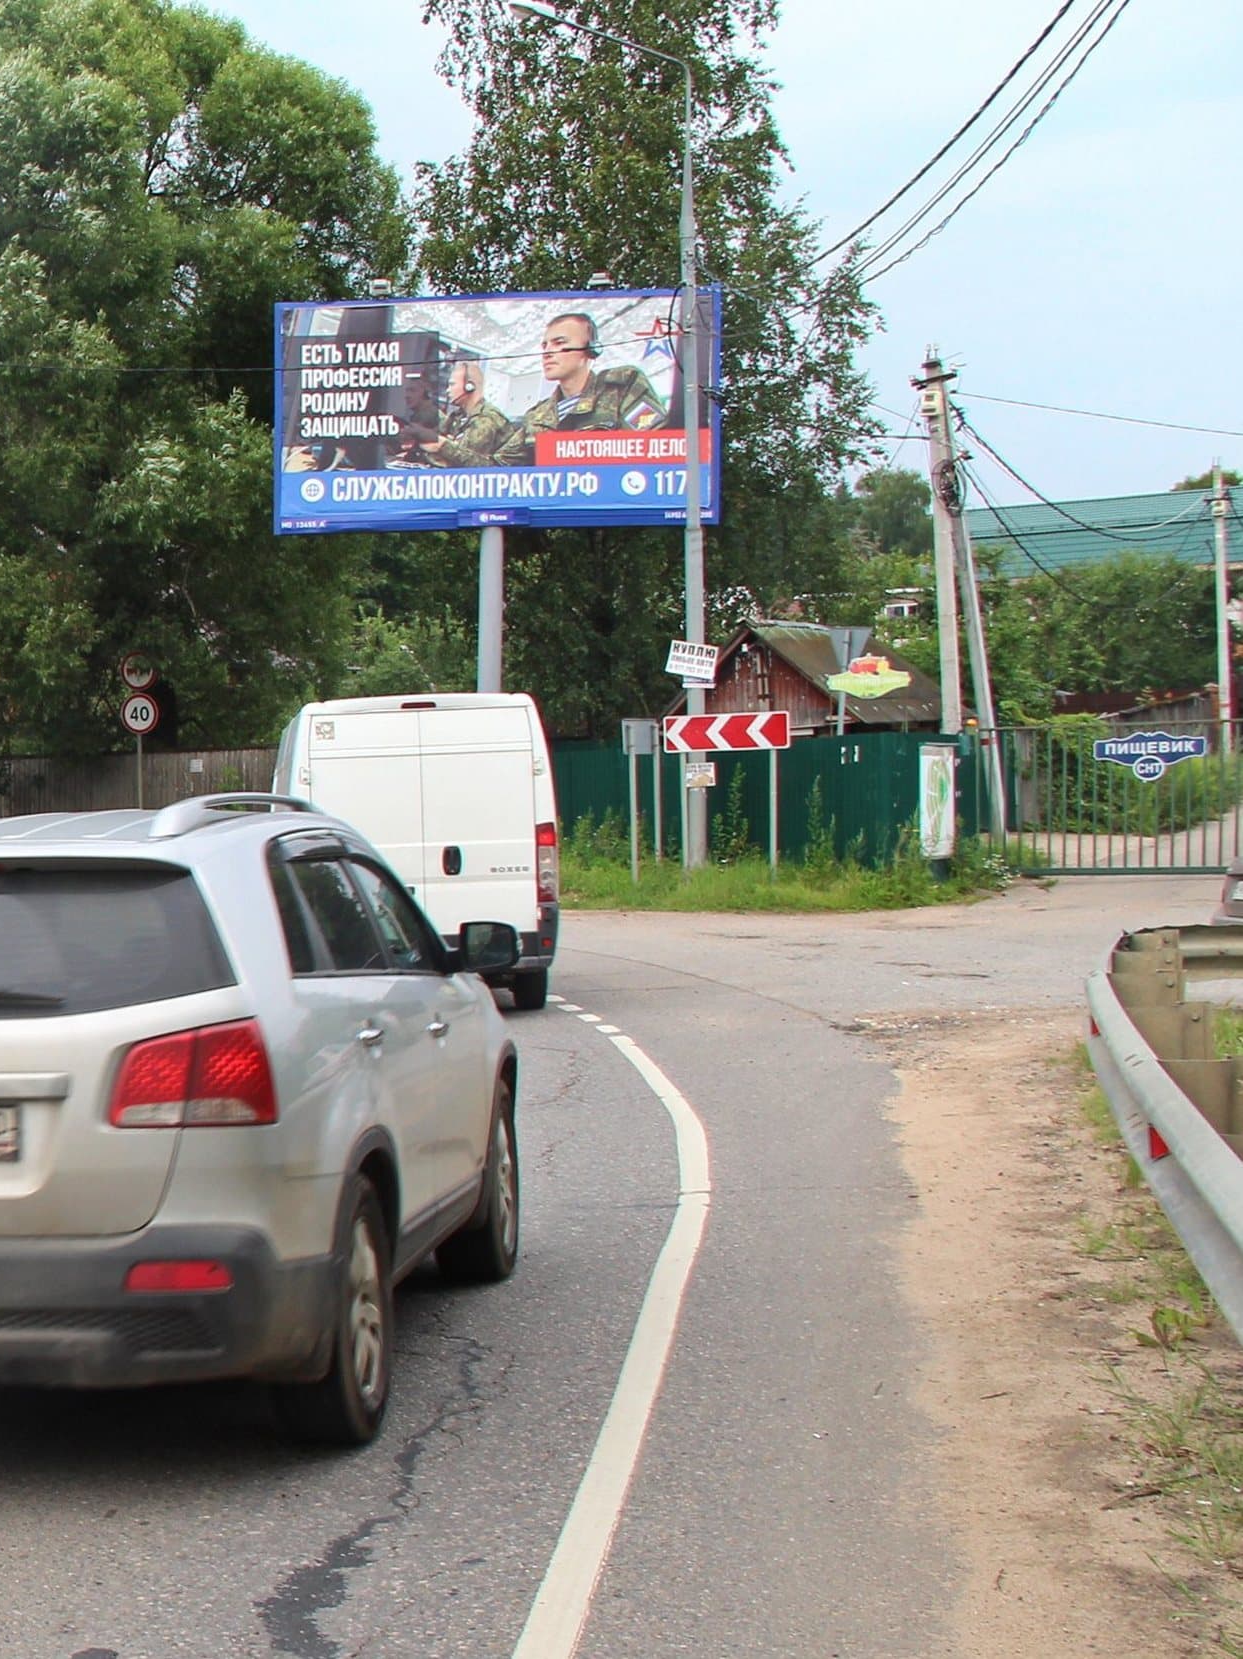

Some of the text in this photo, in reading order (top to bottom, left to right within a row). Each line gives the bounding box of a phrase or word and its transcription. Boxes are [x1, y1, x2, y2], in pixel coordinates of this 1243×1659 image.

[301, 341, 400, 365] ЕСТЬ ТАКАЯ
[301, 365, 403, 389] ПРОФЕССИЯ
[301, 391, 370, 415] РОДИНУ
[300, 415, 400, 439] ЗАЩИЩАТЬ
[556, 438, 645, 459] НАСТОЯЩЕЕ
[332, 471, 599, 501] СЛУЖБАПОКОНТРАКТУ.РФ
[654, 470, 687, 496] 117
[673, 642, 716, 659] КУПЛЮ
[130, 706, 150, 722] 40
[1104, 741, 1196, 755] ПИЩЕВИК
[1136, 762, 1160, 775] СНТ
